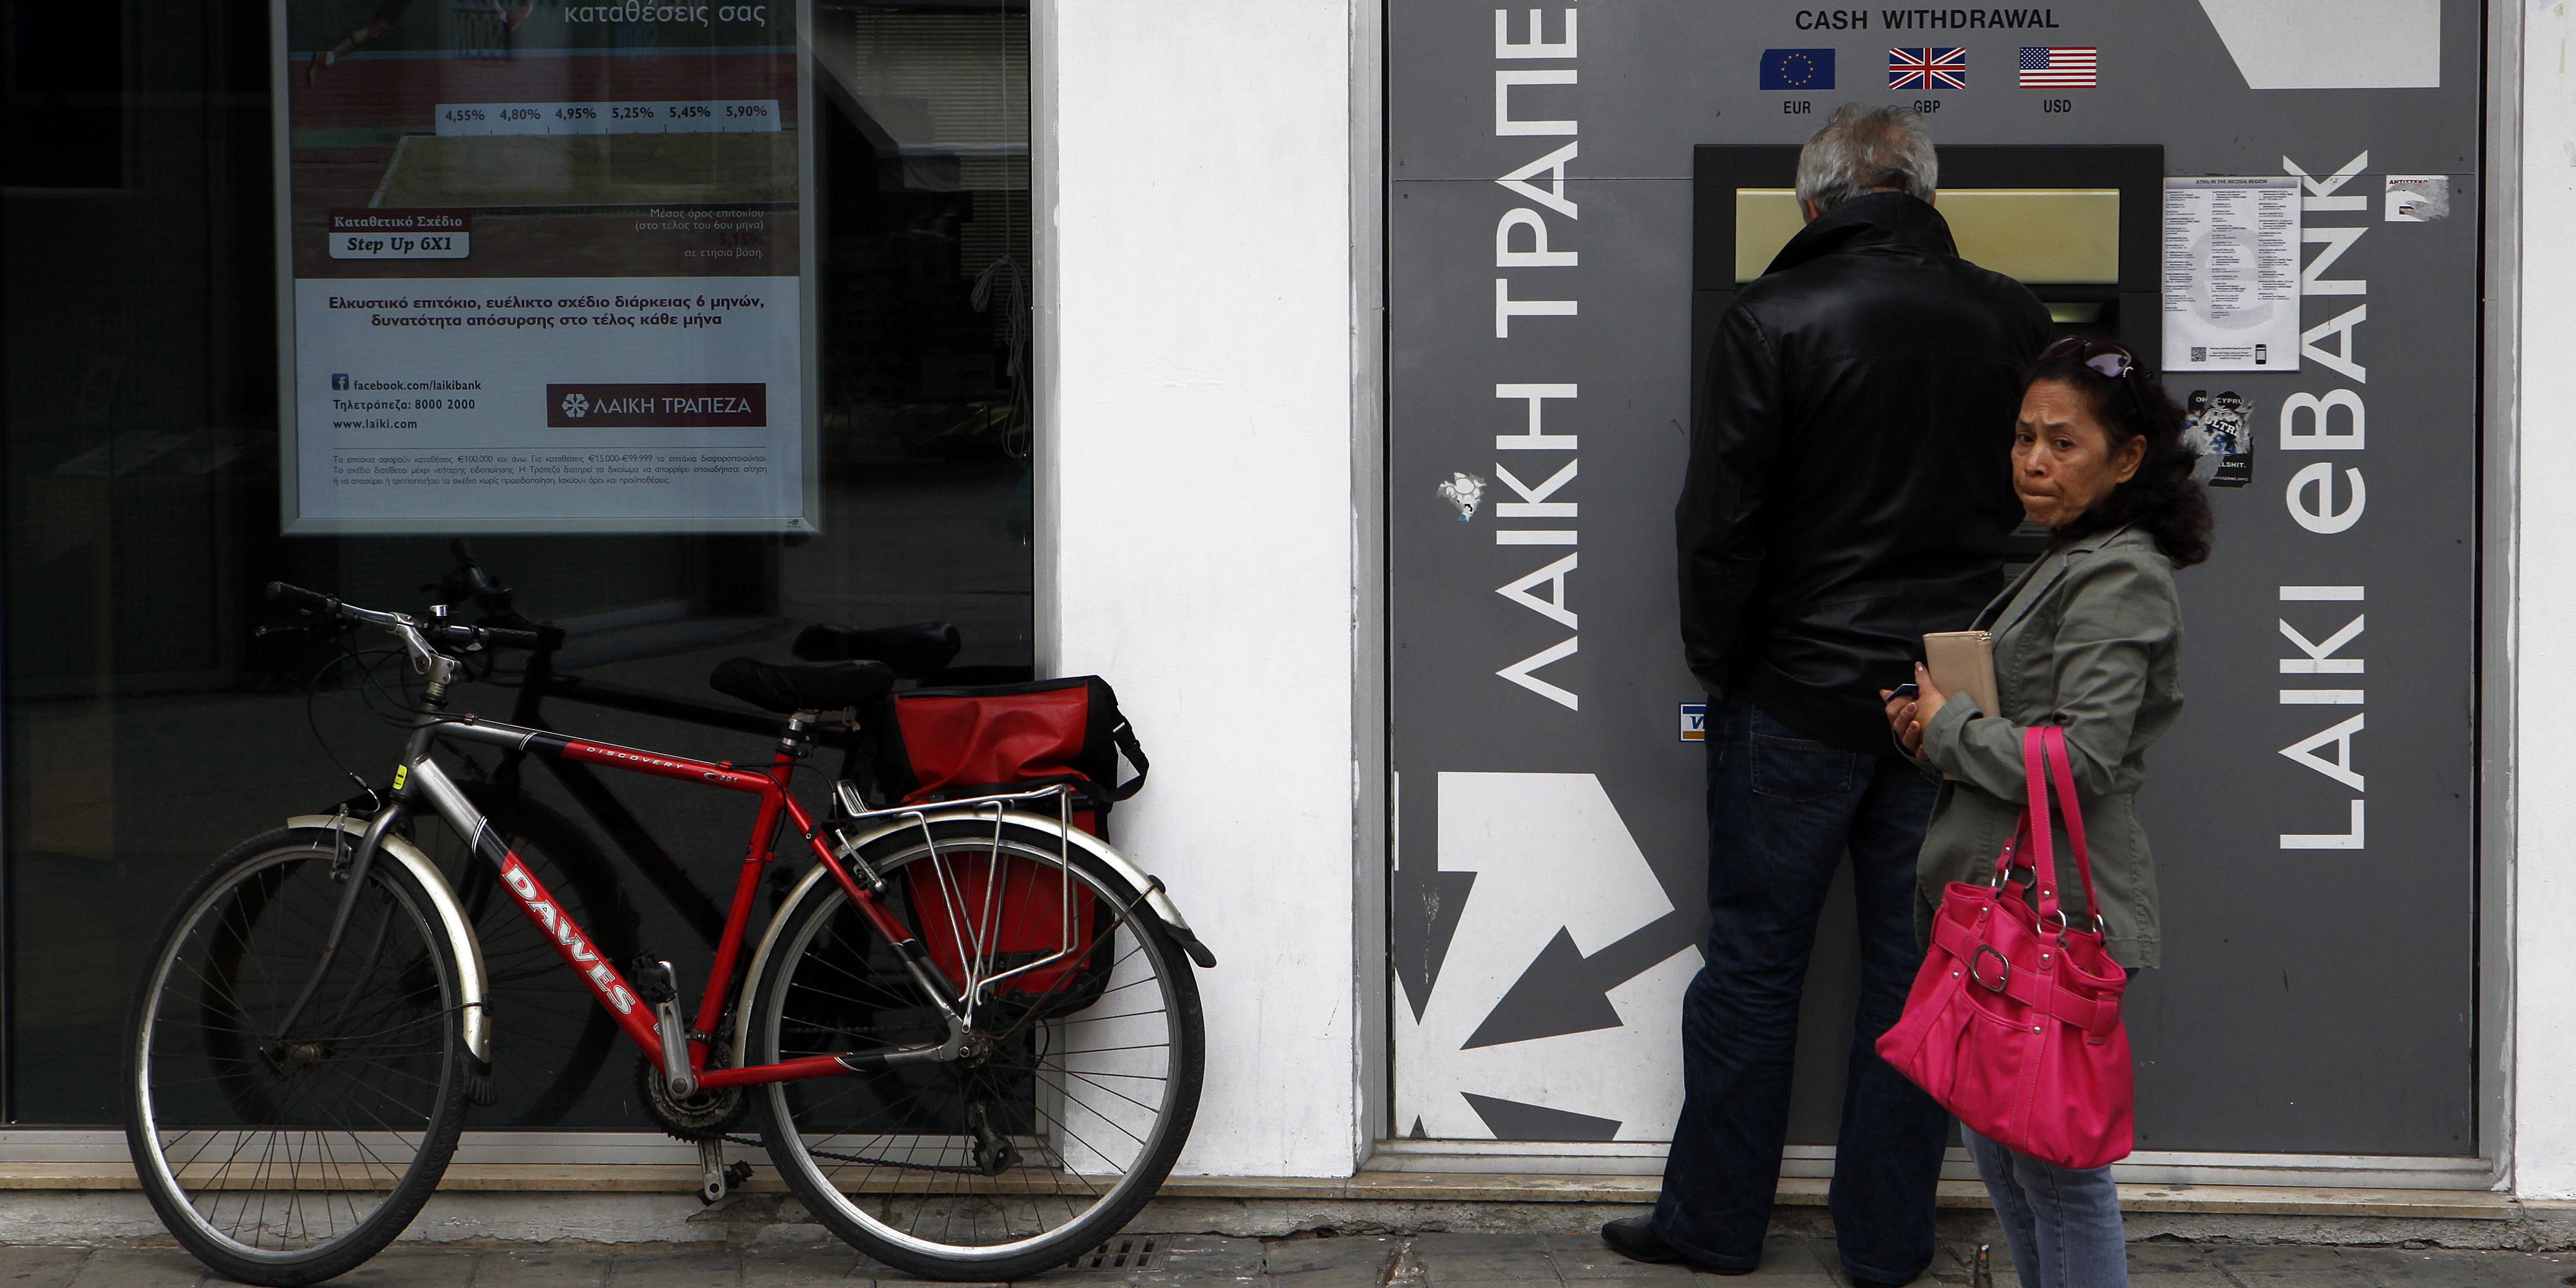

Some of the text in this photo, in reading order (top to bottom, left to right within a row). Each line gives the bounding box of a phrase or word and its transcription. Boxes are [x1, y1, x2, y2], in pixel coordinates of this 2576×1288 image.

[565, 0, 766, 28] καταθέσεις σας
[1795, 8, 2060, 30] CASH WITHDRAWAL
[445, 105, 768, 122] 4,55% 4,80% 4,95% 5,25% 5,45% 5,90%
[1783, 100, 1811, 114] EUR
[1914, 100, 1941, 113] GBP
[2043, 99, 2072, 113] USD
[334, 215, 462, 227] Καταθετικό Σχέδιο
[650, 208, 764, 220] Μέσος όρος επιτοκίου
[635, 220, 658, 232] (στο
[662, 220, 690, 231] τέλος
[714, 220, 733, 229] 6ου
[736, 220, 764, 232] μήνα)
[347, 237, 451, 254] Step Up 6X1
[700, 249, 733, 259] ετήσια
[736, 247, 764, 259] βάση.
[329, 294, 764, 311] Ελκυστικό επιτόκιο, ευέλικτο σχέδιο διάρκειας 6 μηνών,
[371, 312, 722, 330] δυνατότητα απόσυρσης στο τέλος κάθε μήνα
[1495, 0, 1578, 712] ΛΑΙΚΗ ΤΡΑΠΕ
[354, 380, 482, 391] facebook.com/laikibank
[332, 399, 475, 412] Τηλετράπεζα: 8000 2000
[594, 397, 752, 413] ΛΑΙΚΗ ΤΡΑΠΕΖΑ
[332, 419, 417, 429] www.laiki.com
[2278, 149, 2369, 850] LAIKI eBANK
[586, 746, 685, 770] DISCOVERY
[502, 864, 637, 1015] DAWES
